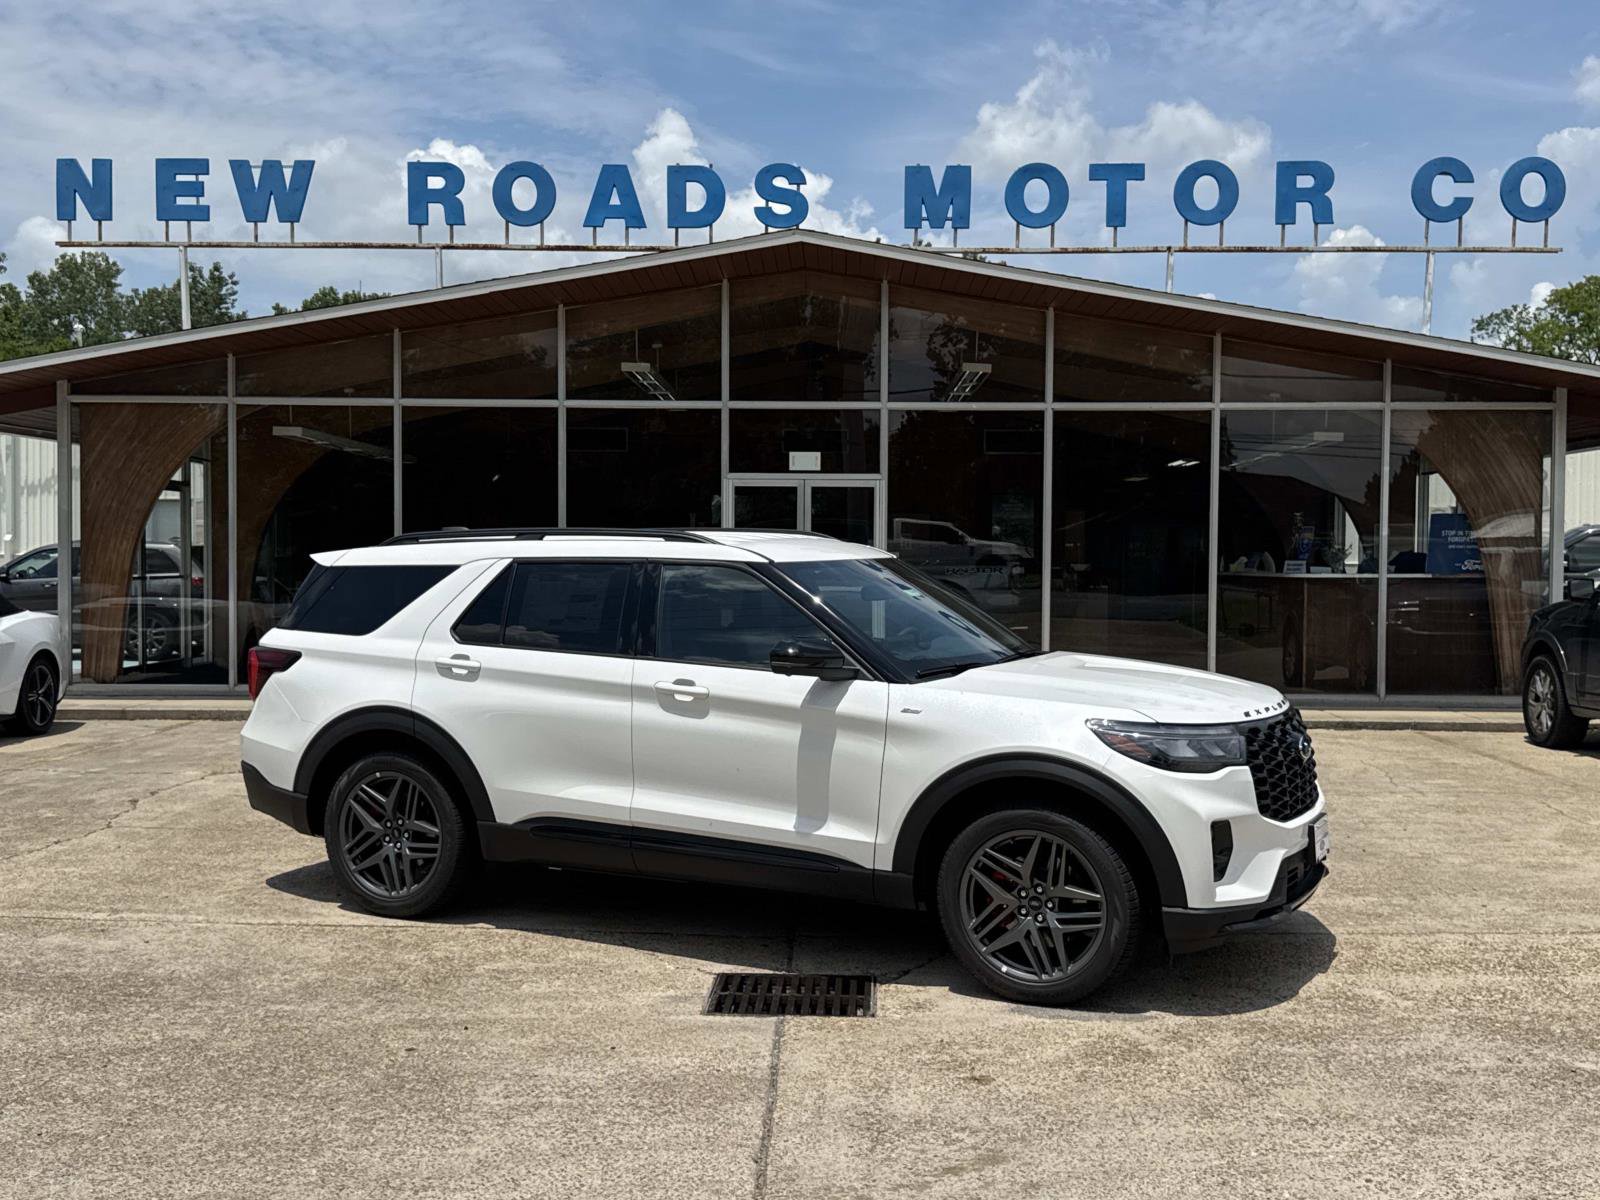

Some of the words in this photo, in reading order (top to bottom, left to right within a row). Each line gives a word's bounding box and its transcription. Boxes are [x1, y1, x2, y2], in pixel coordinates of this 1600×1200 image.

[56, 158, 315, 223] NEW
[407, 160, 809, 229] ROADS
[903, 159, 1335, 229] MOTOR
[1410, 156, 1566, 223] CO
